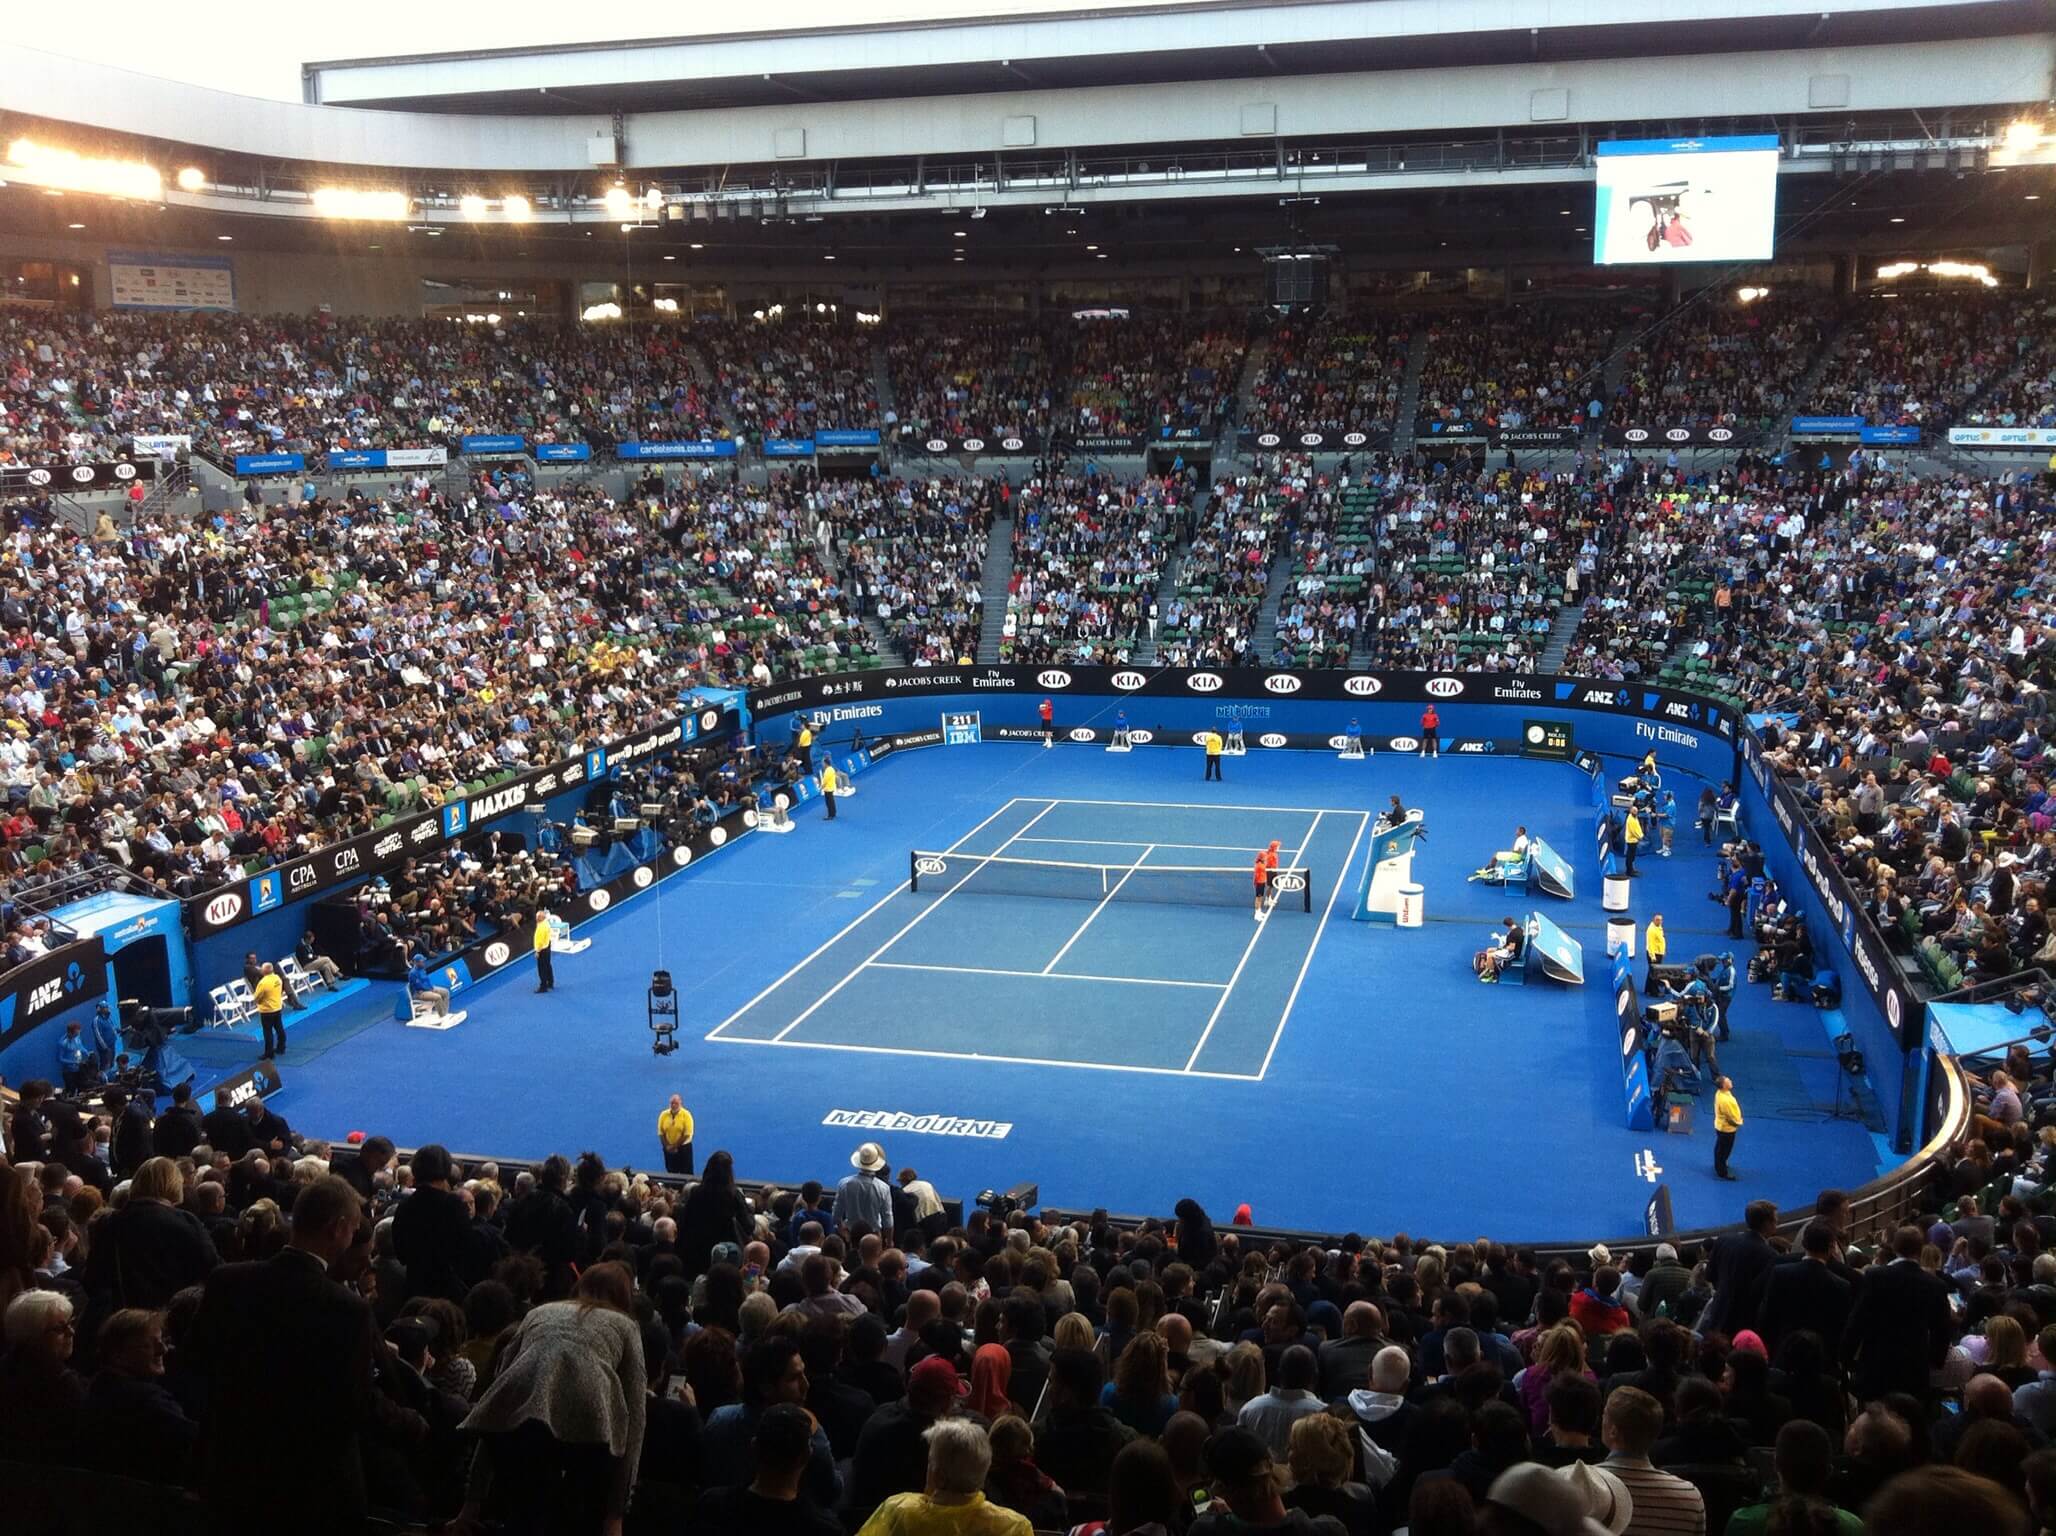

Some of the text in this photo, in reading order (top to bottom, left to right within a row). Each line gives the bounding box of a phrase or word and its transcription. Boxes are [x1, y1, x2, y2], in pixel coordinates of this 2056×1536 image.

[932, 675, 962, 685] CREEK
[988, 670, 1000, 679] Fly
[973, 678, 1015, 688] Emirates
[1512, 680, 1525, 688] Fly
[1494, 687, 1541, 699] Emirates
[1583, 690, 1614, 705] ANZ
[814, 705, 882, 724] Fly Emirates
[1665, 702, 1689, 718] ANZ
[952, 715, 971, 725] 211
[950, 731, 978, 744] IBM
[1636, 722, 1698, 749] Fly Emirates
[1460, 742, 1483, 751] ANZ
[470, 783, 526, 823] MAXXIS
[334, 847, 359, 870] CPA
[290, 863, 316, 886] CPA
[27, 976, 63, 1016] ANZ
[230, 1079, 258, 1108] ANZ
[829, 1111, 1008, 1137] MELBOURNE
